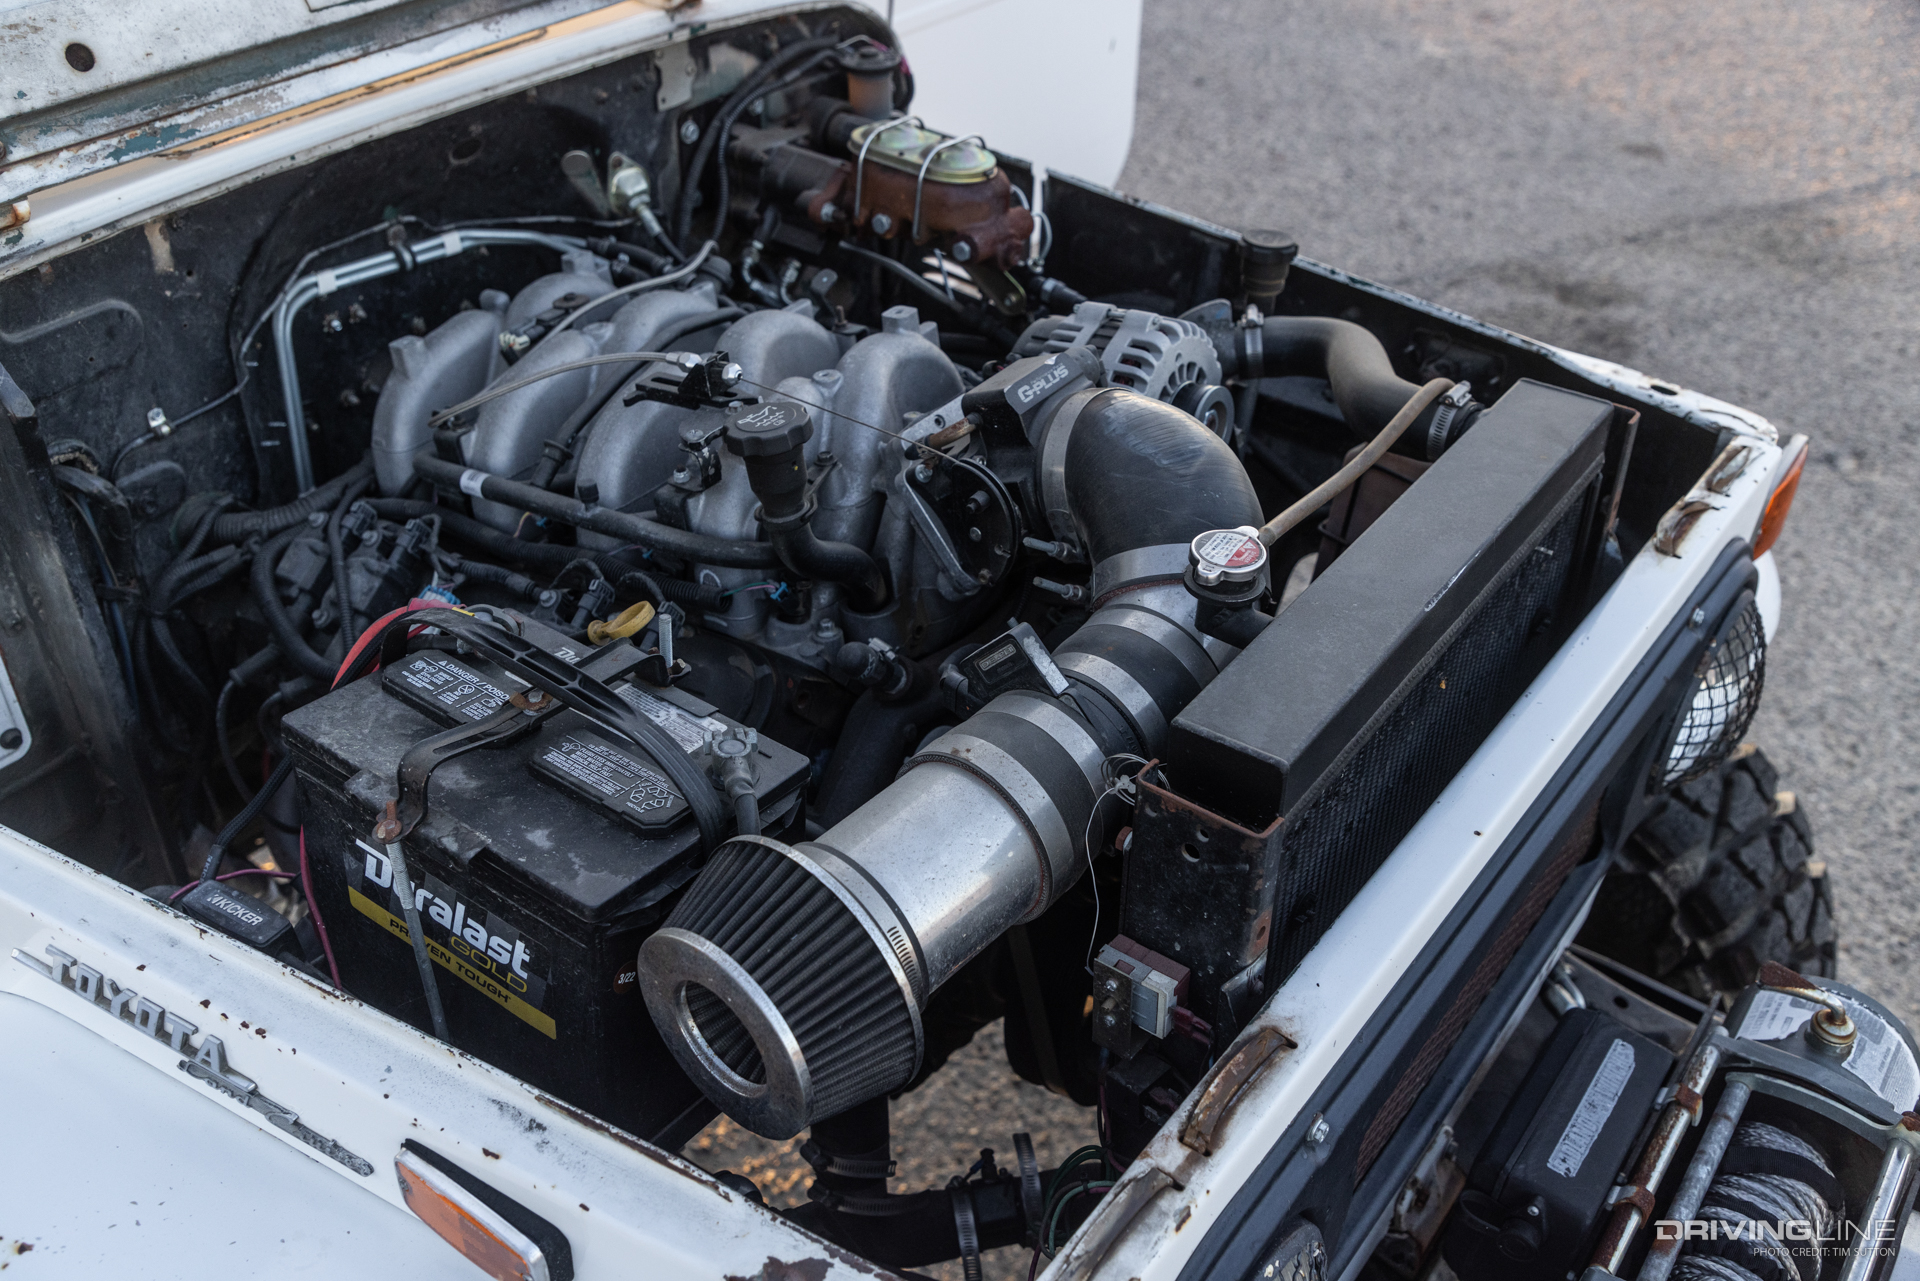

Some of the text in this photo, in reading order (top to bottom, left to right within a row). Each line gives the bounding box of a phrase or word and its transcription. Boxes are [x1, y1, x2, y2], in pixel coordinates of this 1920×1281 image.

[445, 663, 480, 684] DANGER
[483, 684, 512, 701] POISO
[216, 899, 264, 926] KICKER
[451, 936, 528, 993] GOLD
[457, 959, 509, 1004] TOUGH
[618, 971, 636, 985] 3/22
[45, 944, 229, 1075] TOYOTA
